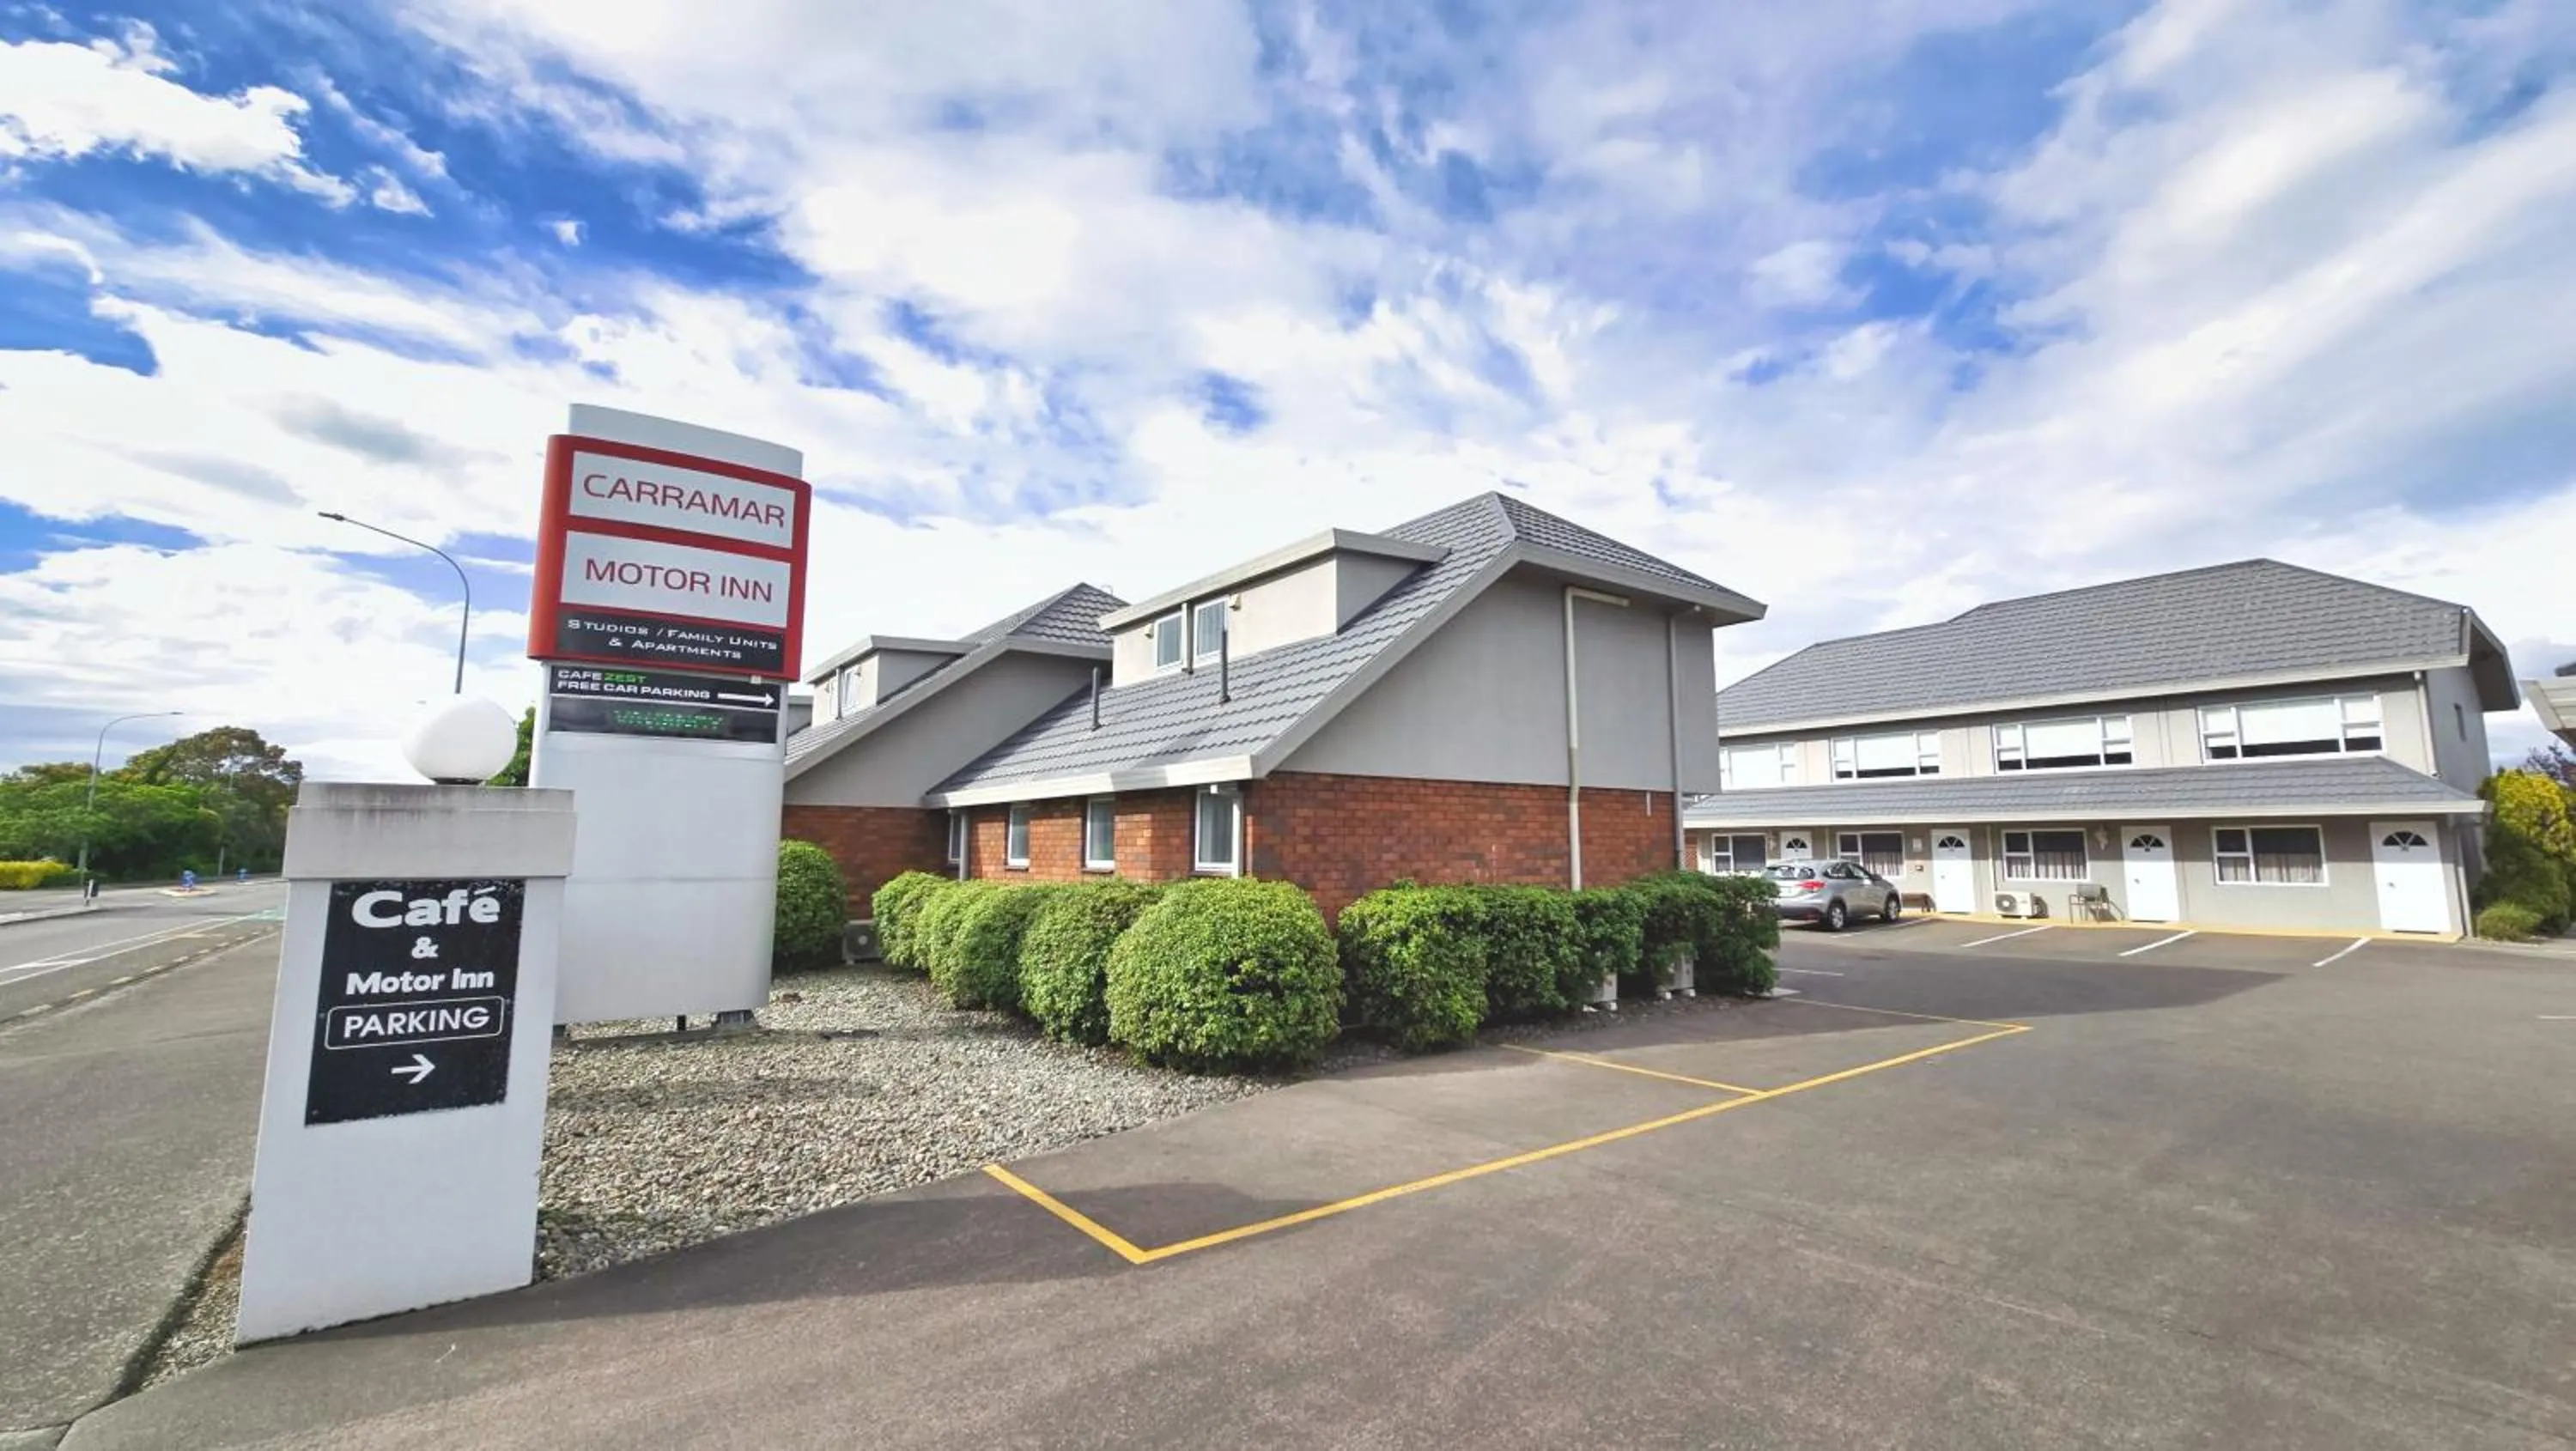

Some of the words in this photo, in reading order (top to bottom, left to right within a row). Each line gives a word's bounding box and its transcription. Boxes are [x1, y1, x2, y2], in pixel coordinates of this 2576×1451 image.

[584, 474, 785, 528] CARRAMAR
[586, 558, 710, 594] MOTOR
[720, 576, 772, 603] INN
[568, 619, 648, 635] STUDIOS
[667, 629, 723, 643] FAMILY
[729, 636, 777, 650] UNITS
[608, 638, 623, 647] &
[631, 640, 742, 659] APARTMENTS
[557, 681, 600, 691] FREE
[604, 683, 638, 694] CAR
[641, 687, 710, 699] PARKING
[558, 670, 602, 681] CAFE
[352, 886, 501, 927] Café
[412, 937, 439, 959] &
[345, 972, 445, 995] Motor
[452, 968, 494, 989] Inn
[343, 1006, 490, 1038] PARKING
